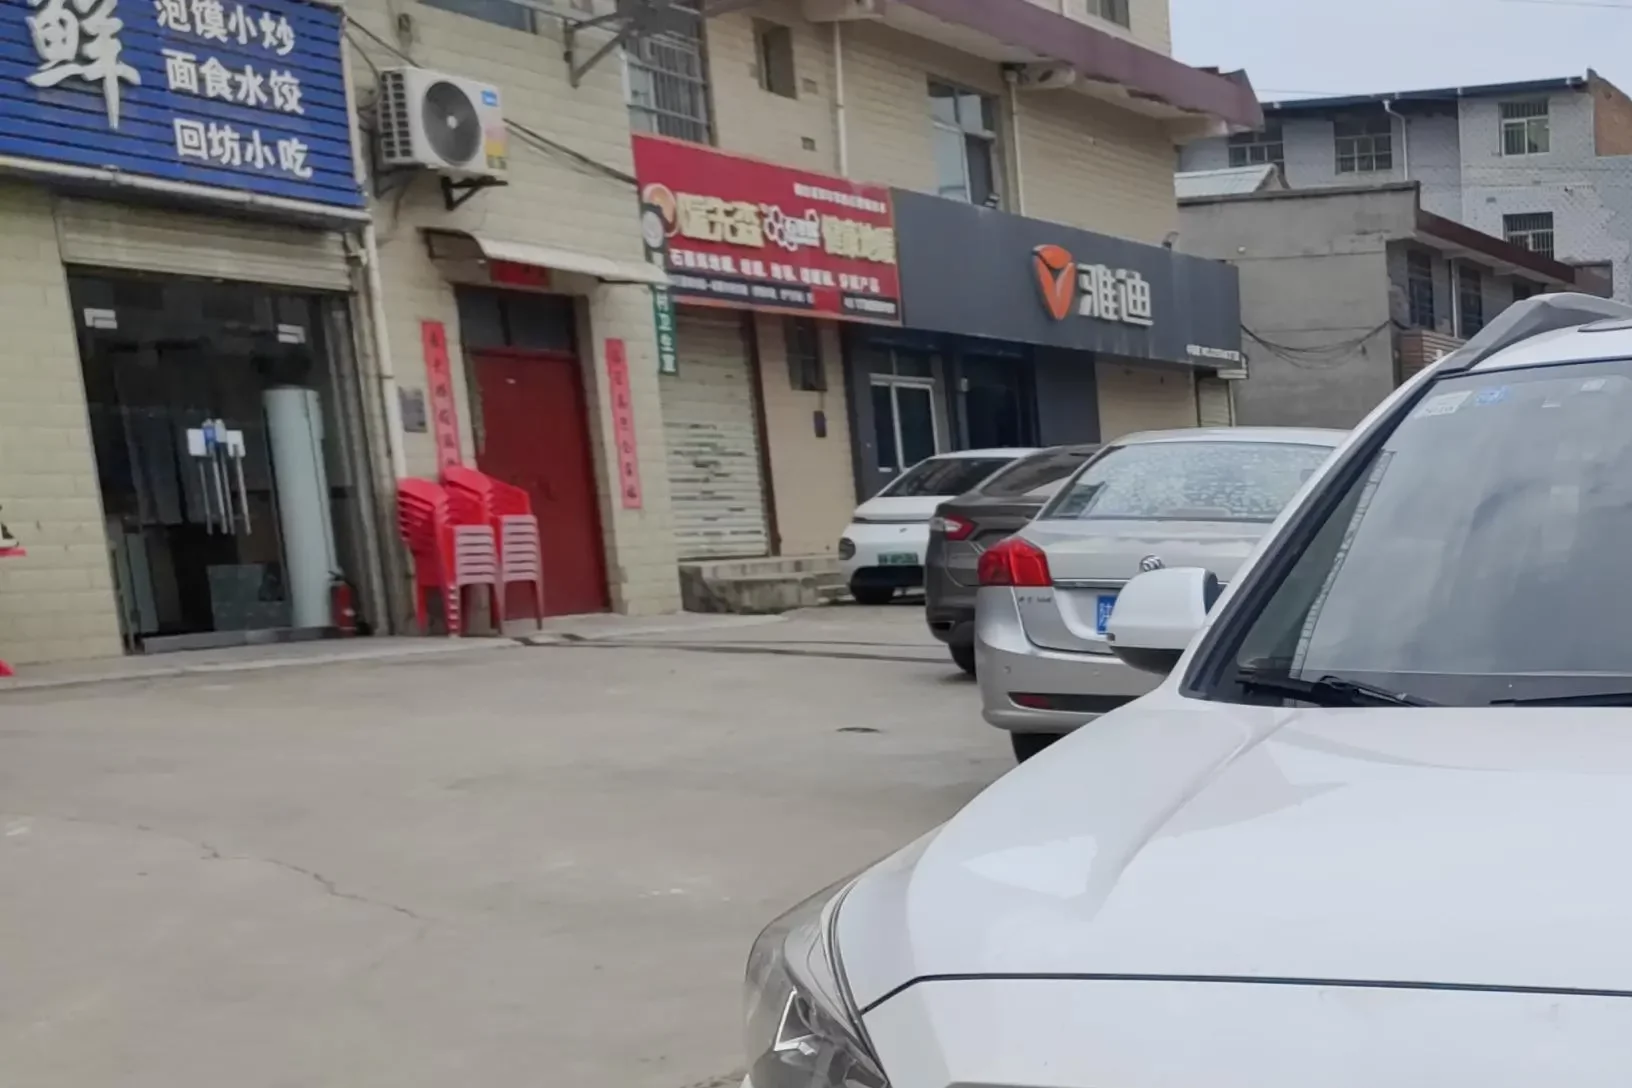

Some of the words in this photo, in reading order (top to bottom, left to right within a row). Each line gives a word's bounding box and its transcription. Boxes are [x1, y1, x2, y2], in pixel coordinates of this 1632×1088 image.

[153, 0, 296, 55] 泡馍小炒
[26, 0, 142, 130] 鲜
[161, 49, 305, 114] 面食水饺
[173, 118, 313, 178] 回坊小吃
[1077, 264, 1154, 326] 雅迪
